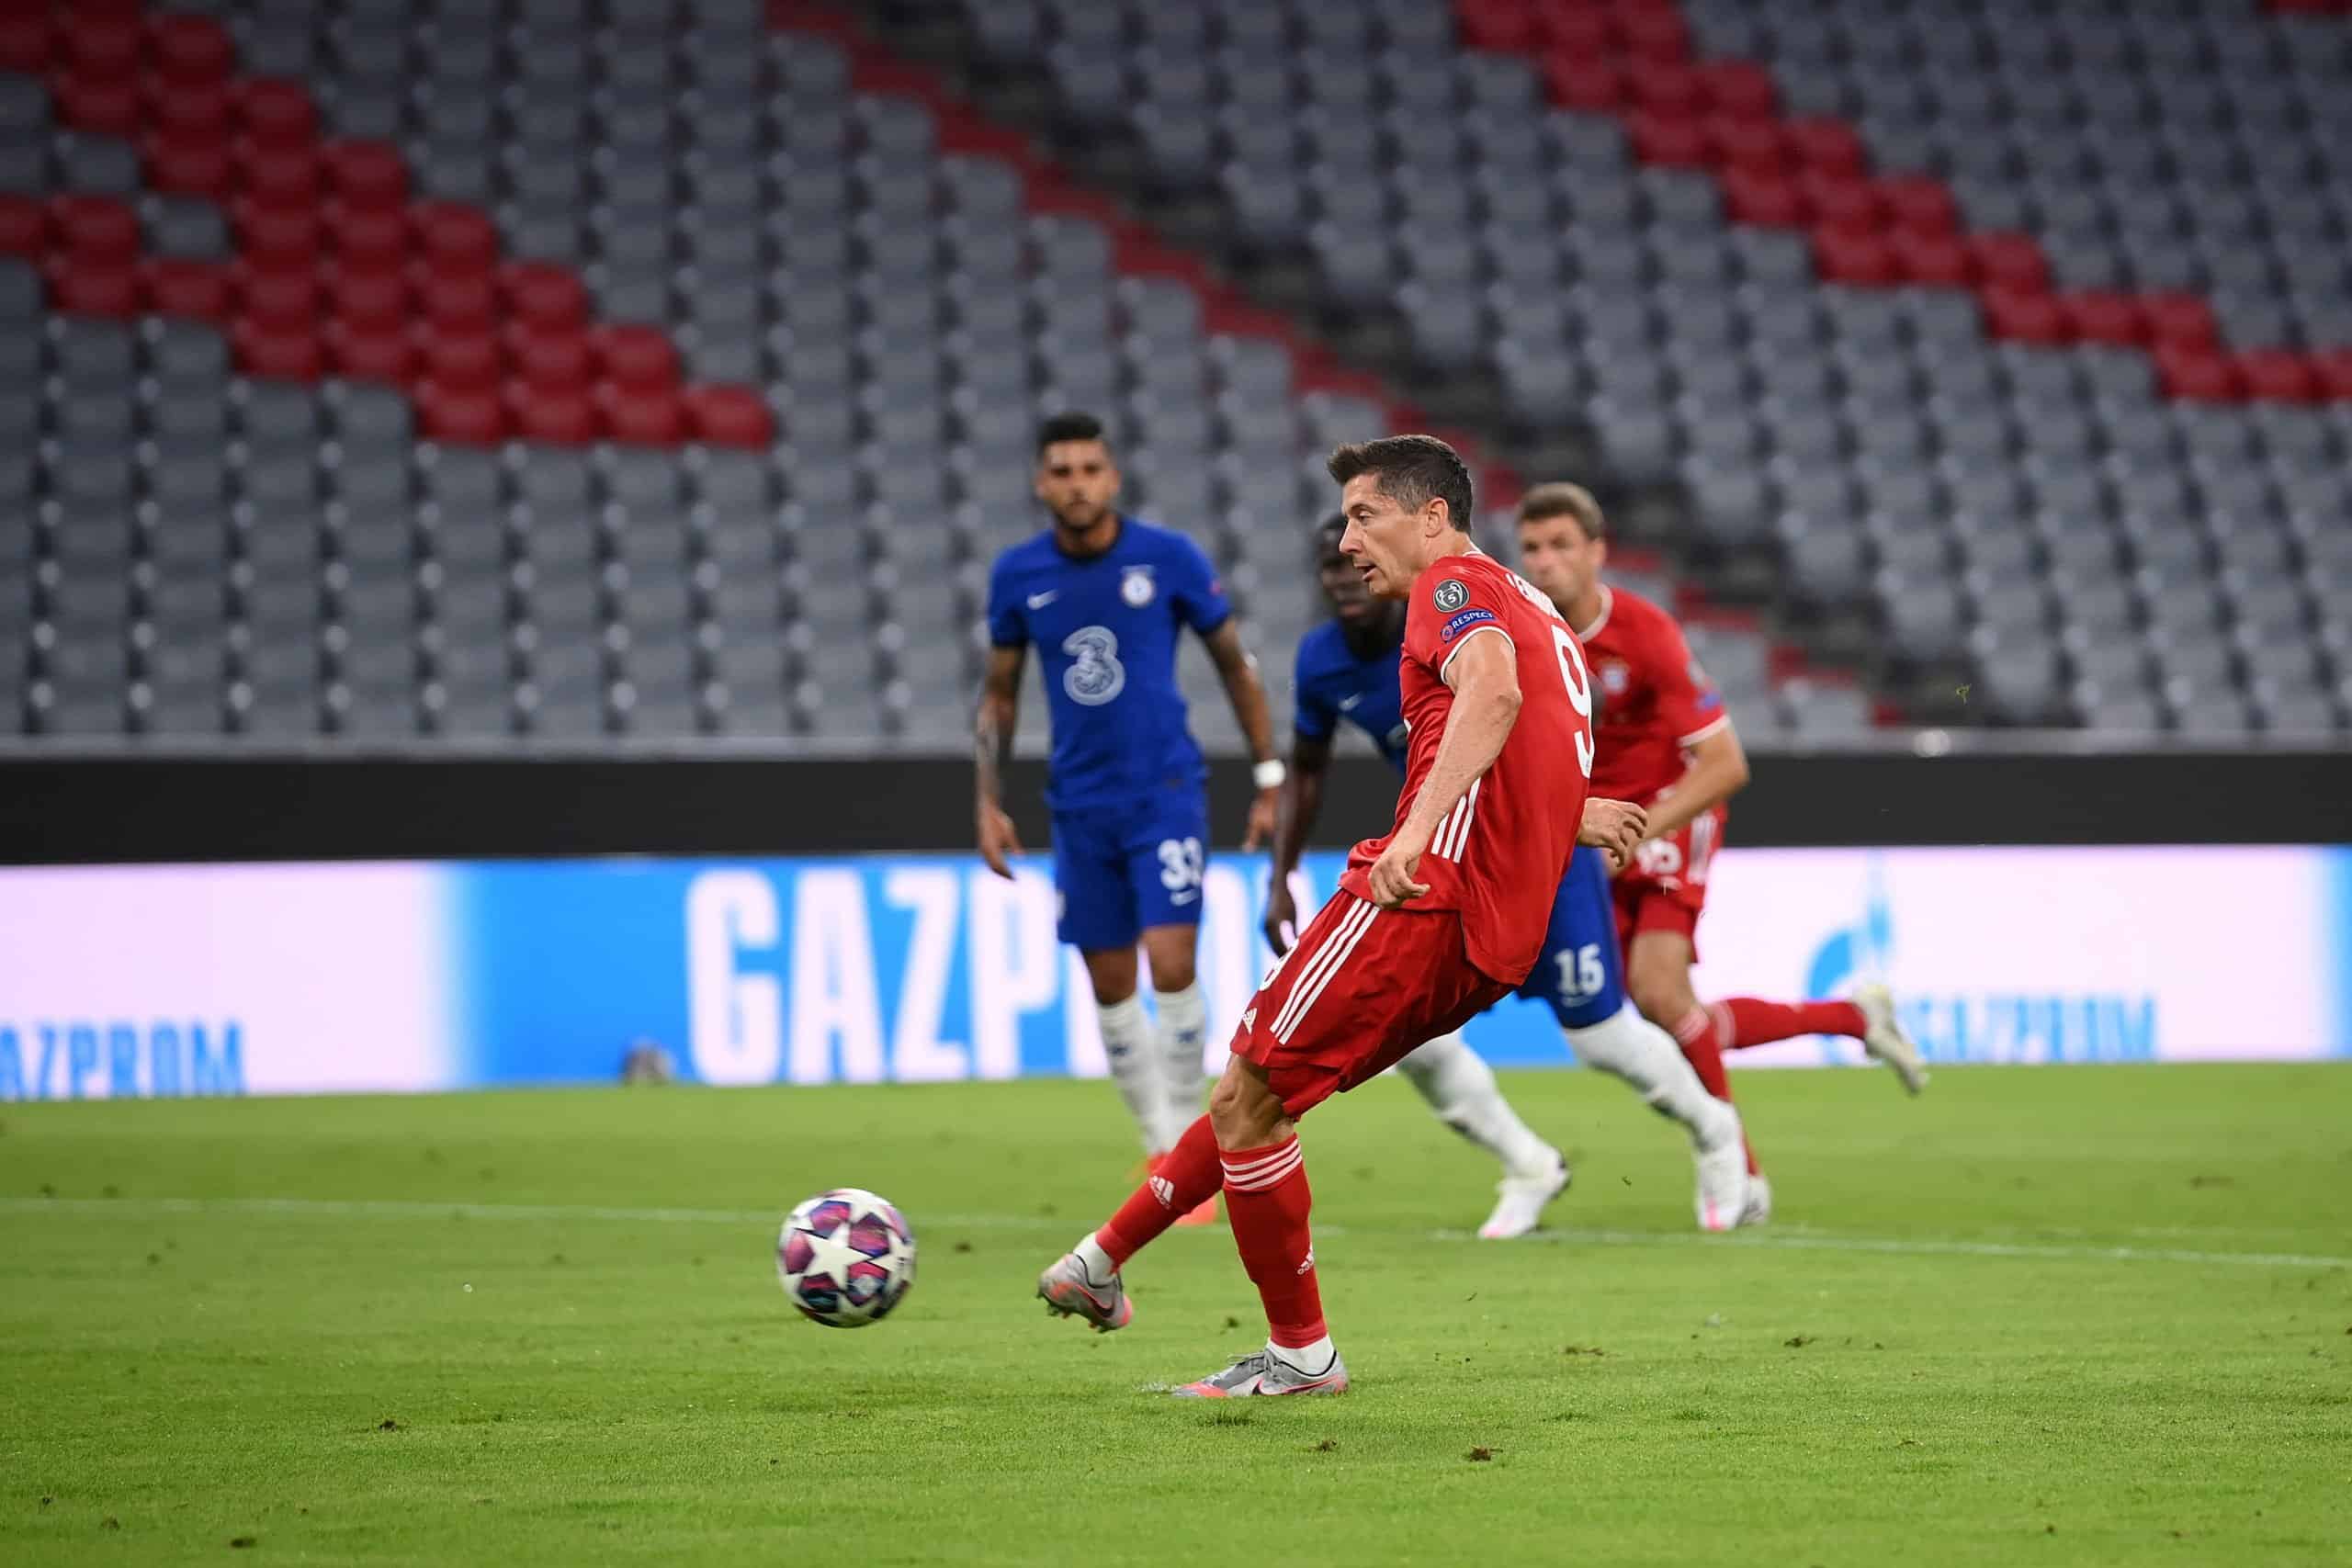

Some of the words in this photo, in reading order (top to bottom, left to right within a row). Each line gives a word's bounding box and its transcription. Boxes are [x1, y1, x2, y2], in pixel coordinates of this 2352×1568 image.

[1448, 594, 1456, 604] 5
[1452, 611, 1493, 629] RESPECT
[1062, 625, 1125, 706] 3
[1551, 624, 1595, 779] 9
[1157, 835, 1203, 891] 33
[1554, 942, 1606, 998] 15
